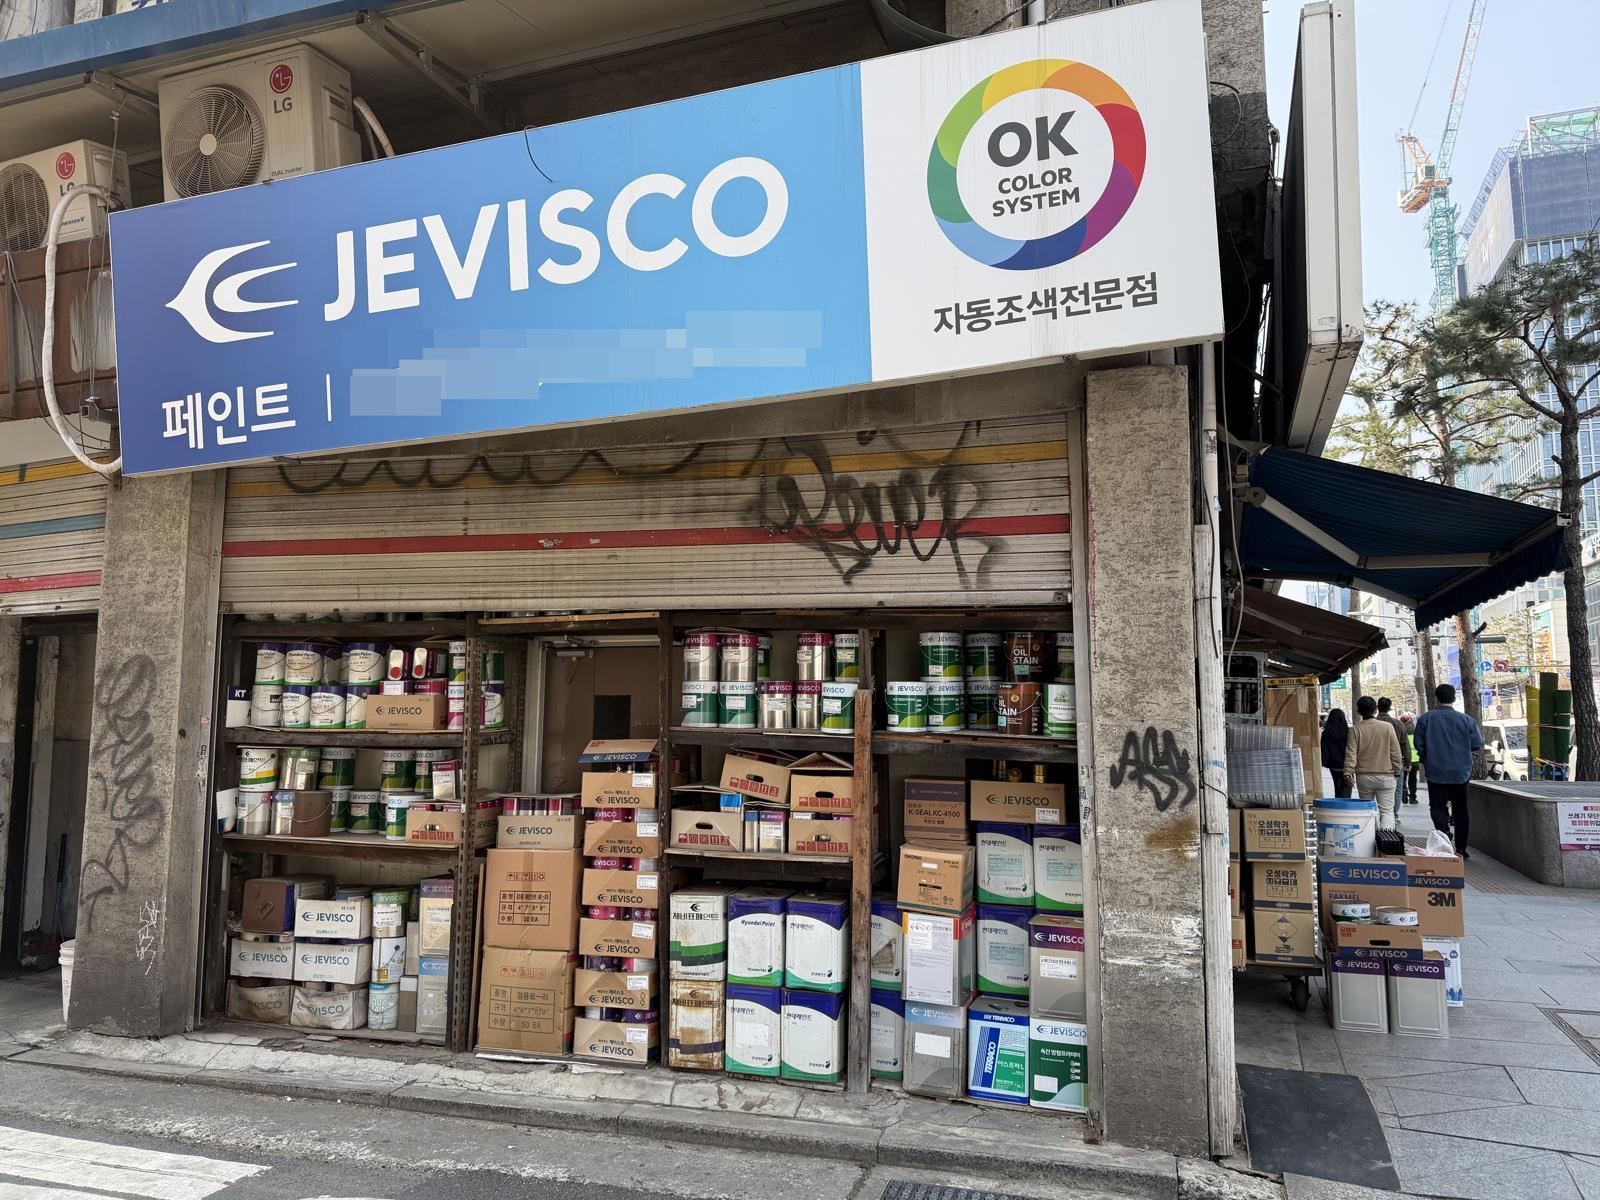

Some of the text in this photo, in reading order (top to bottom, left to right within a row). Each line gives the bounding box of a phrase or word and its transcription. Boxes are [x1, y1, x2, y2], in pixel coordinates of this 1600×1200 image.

[273, 97, 293, 113] LG
[987, 110, 1079, 167] OK
[998, 167, 1072, 194] COLOR
[992, 187, 1080, 217] SYSTEM
[323, 156, 789, 321] JEVISCO
[933, 271, 1158, 334] 자동조색전문점
[162, 383, 296, 449] 페인트
[234, 689, 247, 698] KT
[387, 707, 422, 715] JEVISCO
[607, 796, 640, 804] JEVISCO
[1003, 795, 1049, 806] JEVISCO
[1258, 821, 1289, 829] 오성락카
[518, 826, 552, 835] JEVISCO
[610, 845, 643, 854] JEVISCO
[1266, 870, 1297, 878] 오성락카
[1347, 868, 1400, 880] JEVISCO
[1414, 877, 1450, 886] JEVISCO
[609, 895, 643, 904] JEVISCO
[1427, 892, 1456, 907] 3M
[316, 913, 353, 923] JEVISCO
[1048, 933, 1084, 944] JEVISCO
[606, 945, 640, 954] JEVISCO
[1369, 950, 1408, 958] JEVISCO
[252, 953, 287, 963] JEVISCO
[314, 955, 349, 965] JEVISCO
[1346, 961, 1380, 969] JEVISCO
[1406, 965, 1439, 974] JEVISCO
[601, 996, 634, 1005] JEVISCO
[1050, 1027, 1087, 1038] JEVISCO
[601, 1046, 634, 1056] JEVISCO
